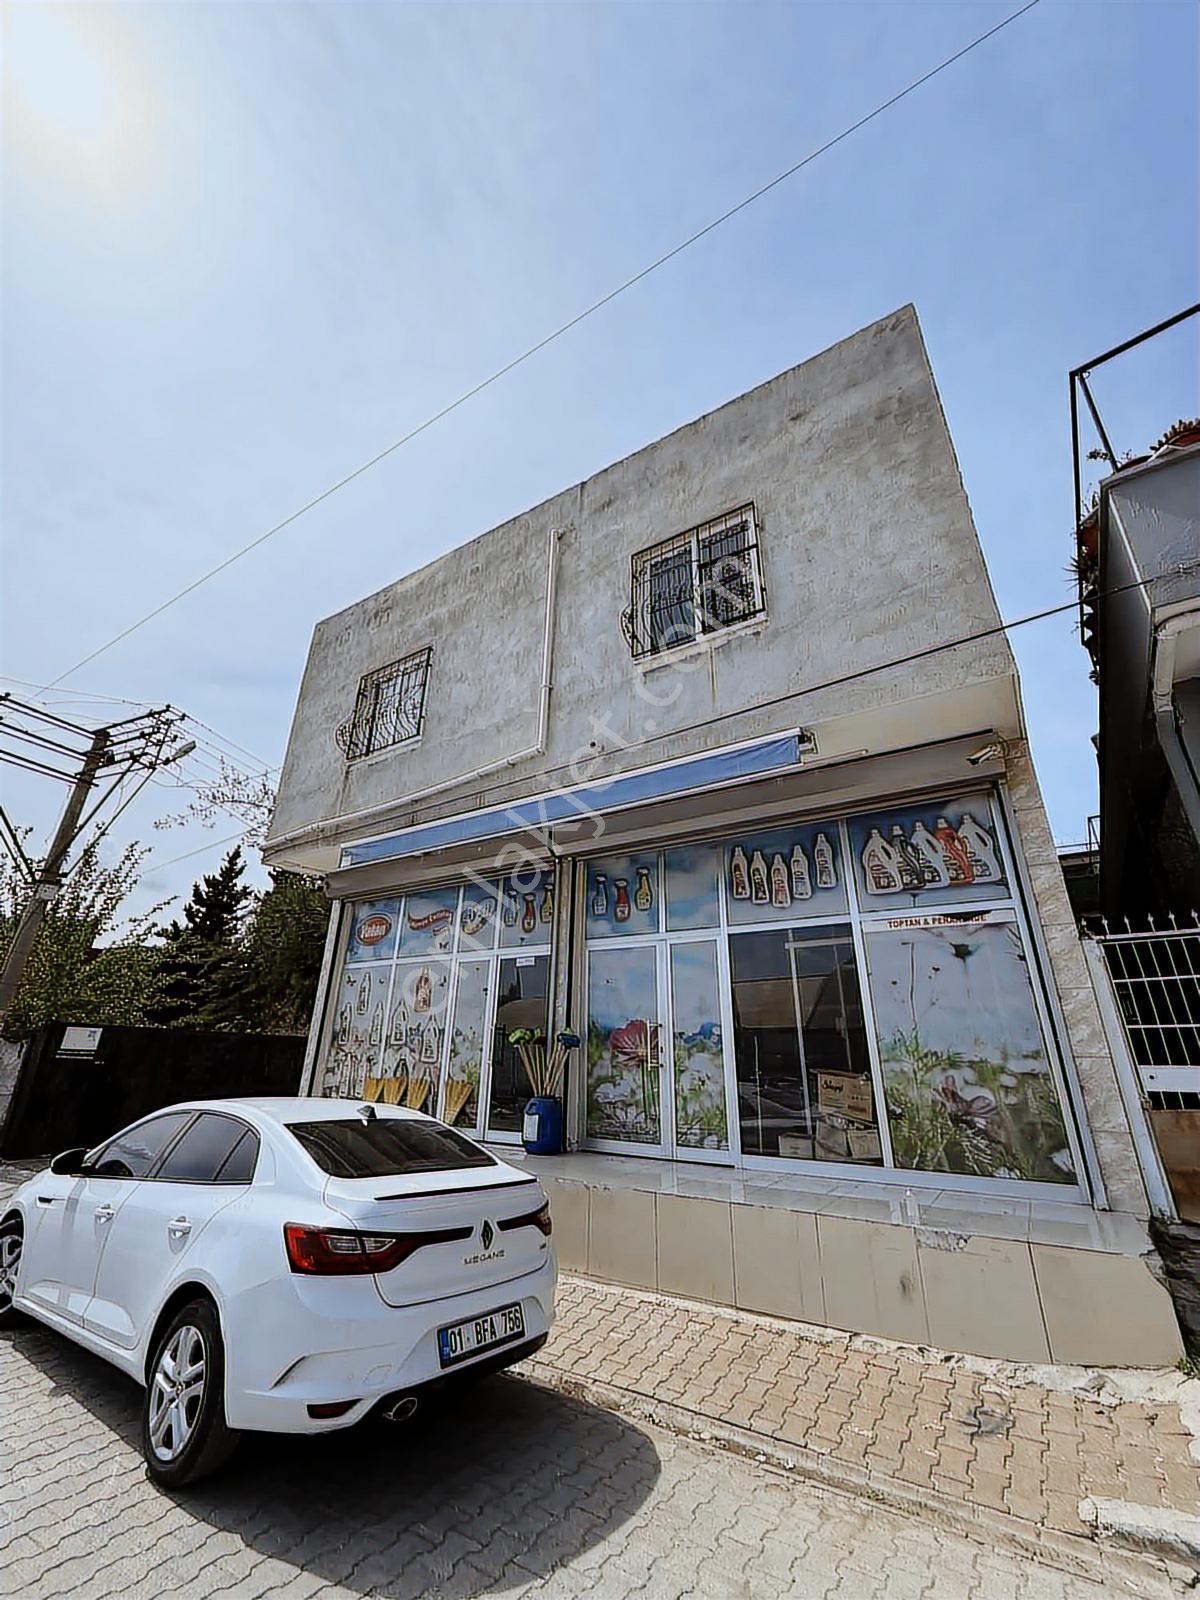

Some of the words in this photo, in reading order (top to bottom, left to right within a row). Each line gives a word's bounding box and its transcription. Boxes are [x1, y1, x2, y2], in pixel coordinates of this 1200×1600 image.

[888, 918, 921, 929] TOPTAN
[464, 1250, 505, 1265] MEGANE
[449, 1327, 464, 1354] 01
[474, 1316, 497, 1345] BFA
[501, 1308, 521, 1335] 756
